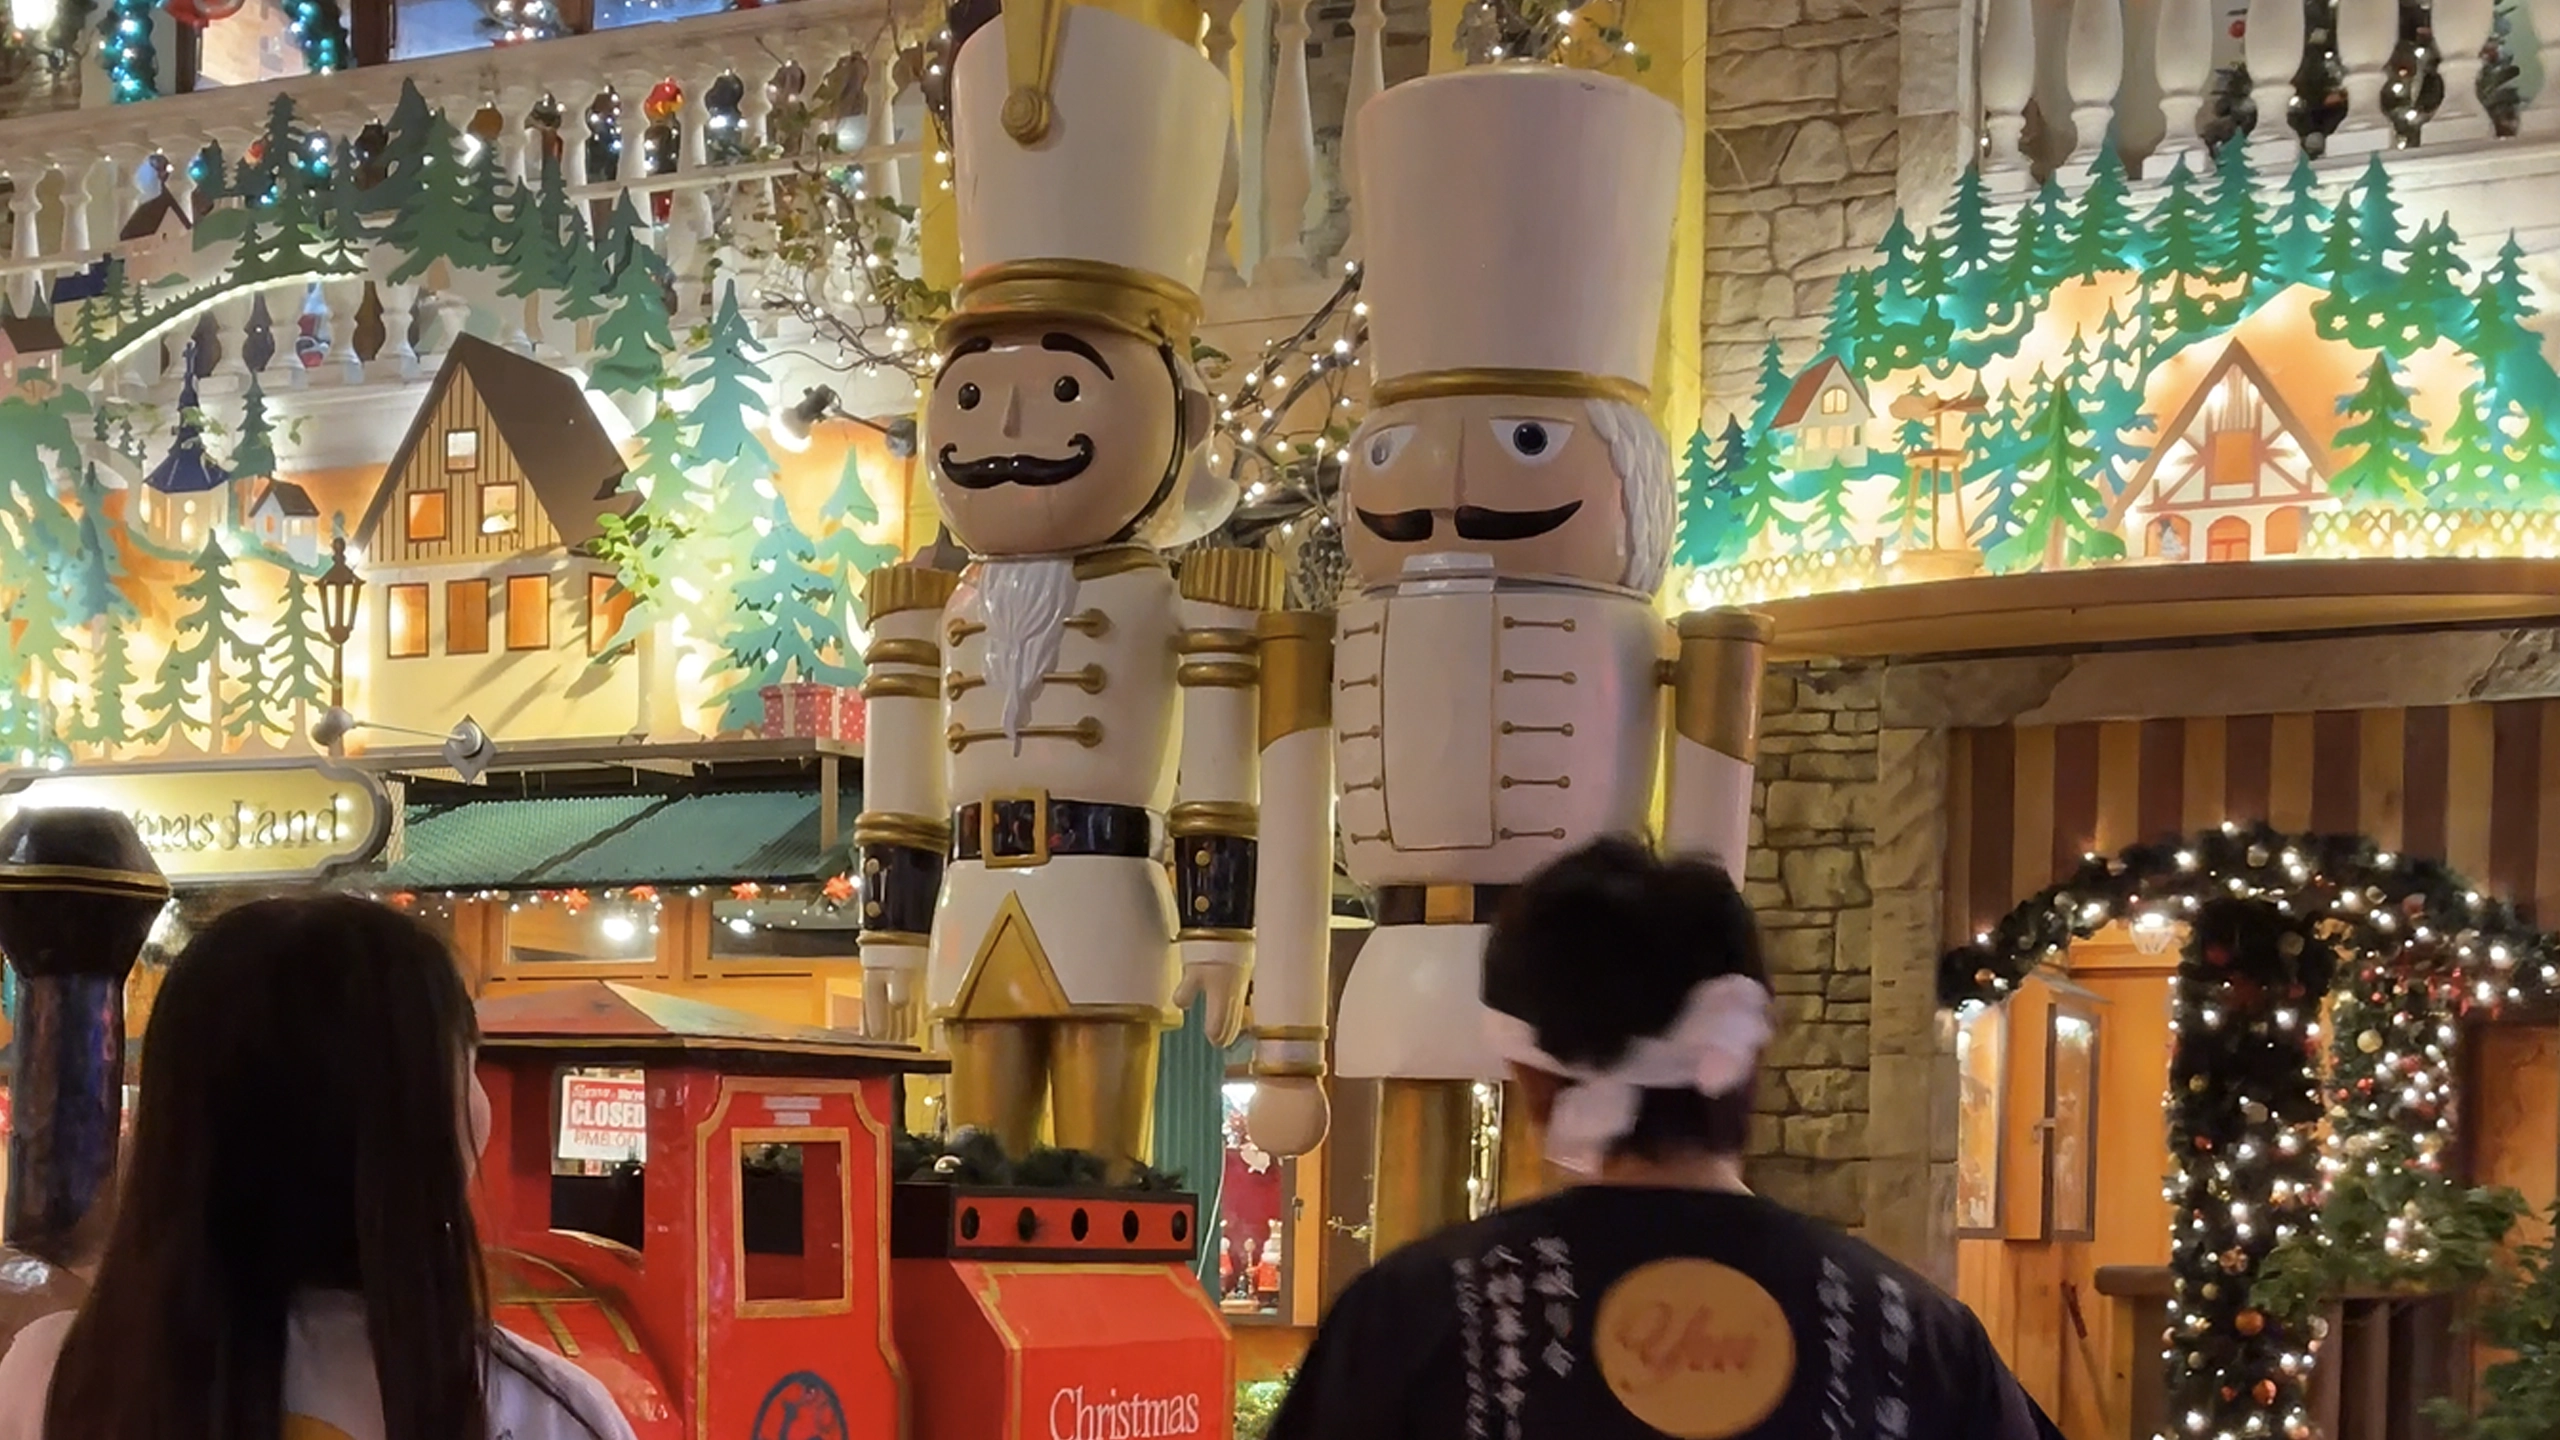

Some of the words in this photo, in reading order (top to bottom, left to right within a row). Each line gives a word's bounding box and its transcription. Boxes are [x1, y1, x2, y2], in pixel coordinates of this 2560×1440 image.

[221, 792, 339, 850] Land
[570, 1100, 645, 1128] CLOSED
[1050, 1384, 1200, 1440] Christmas
